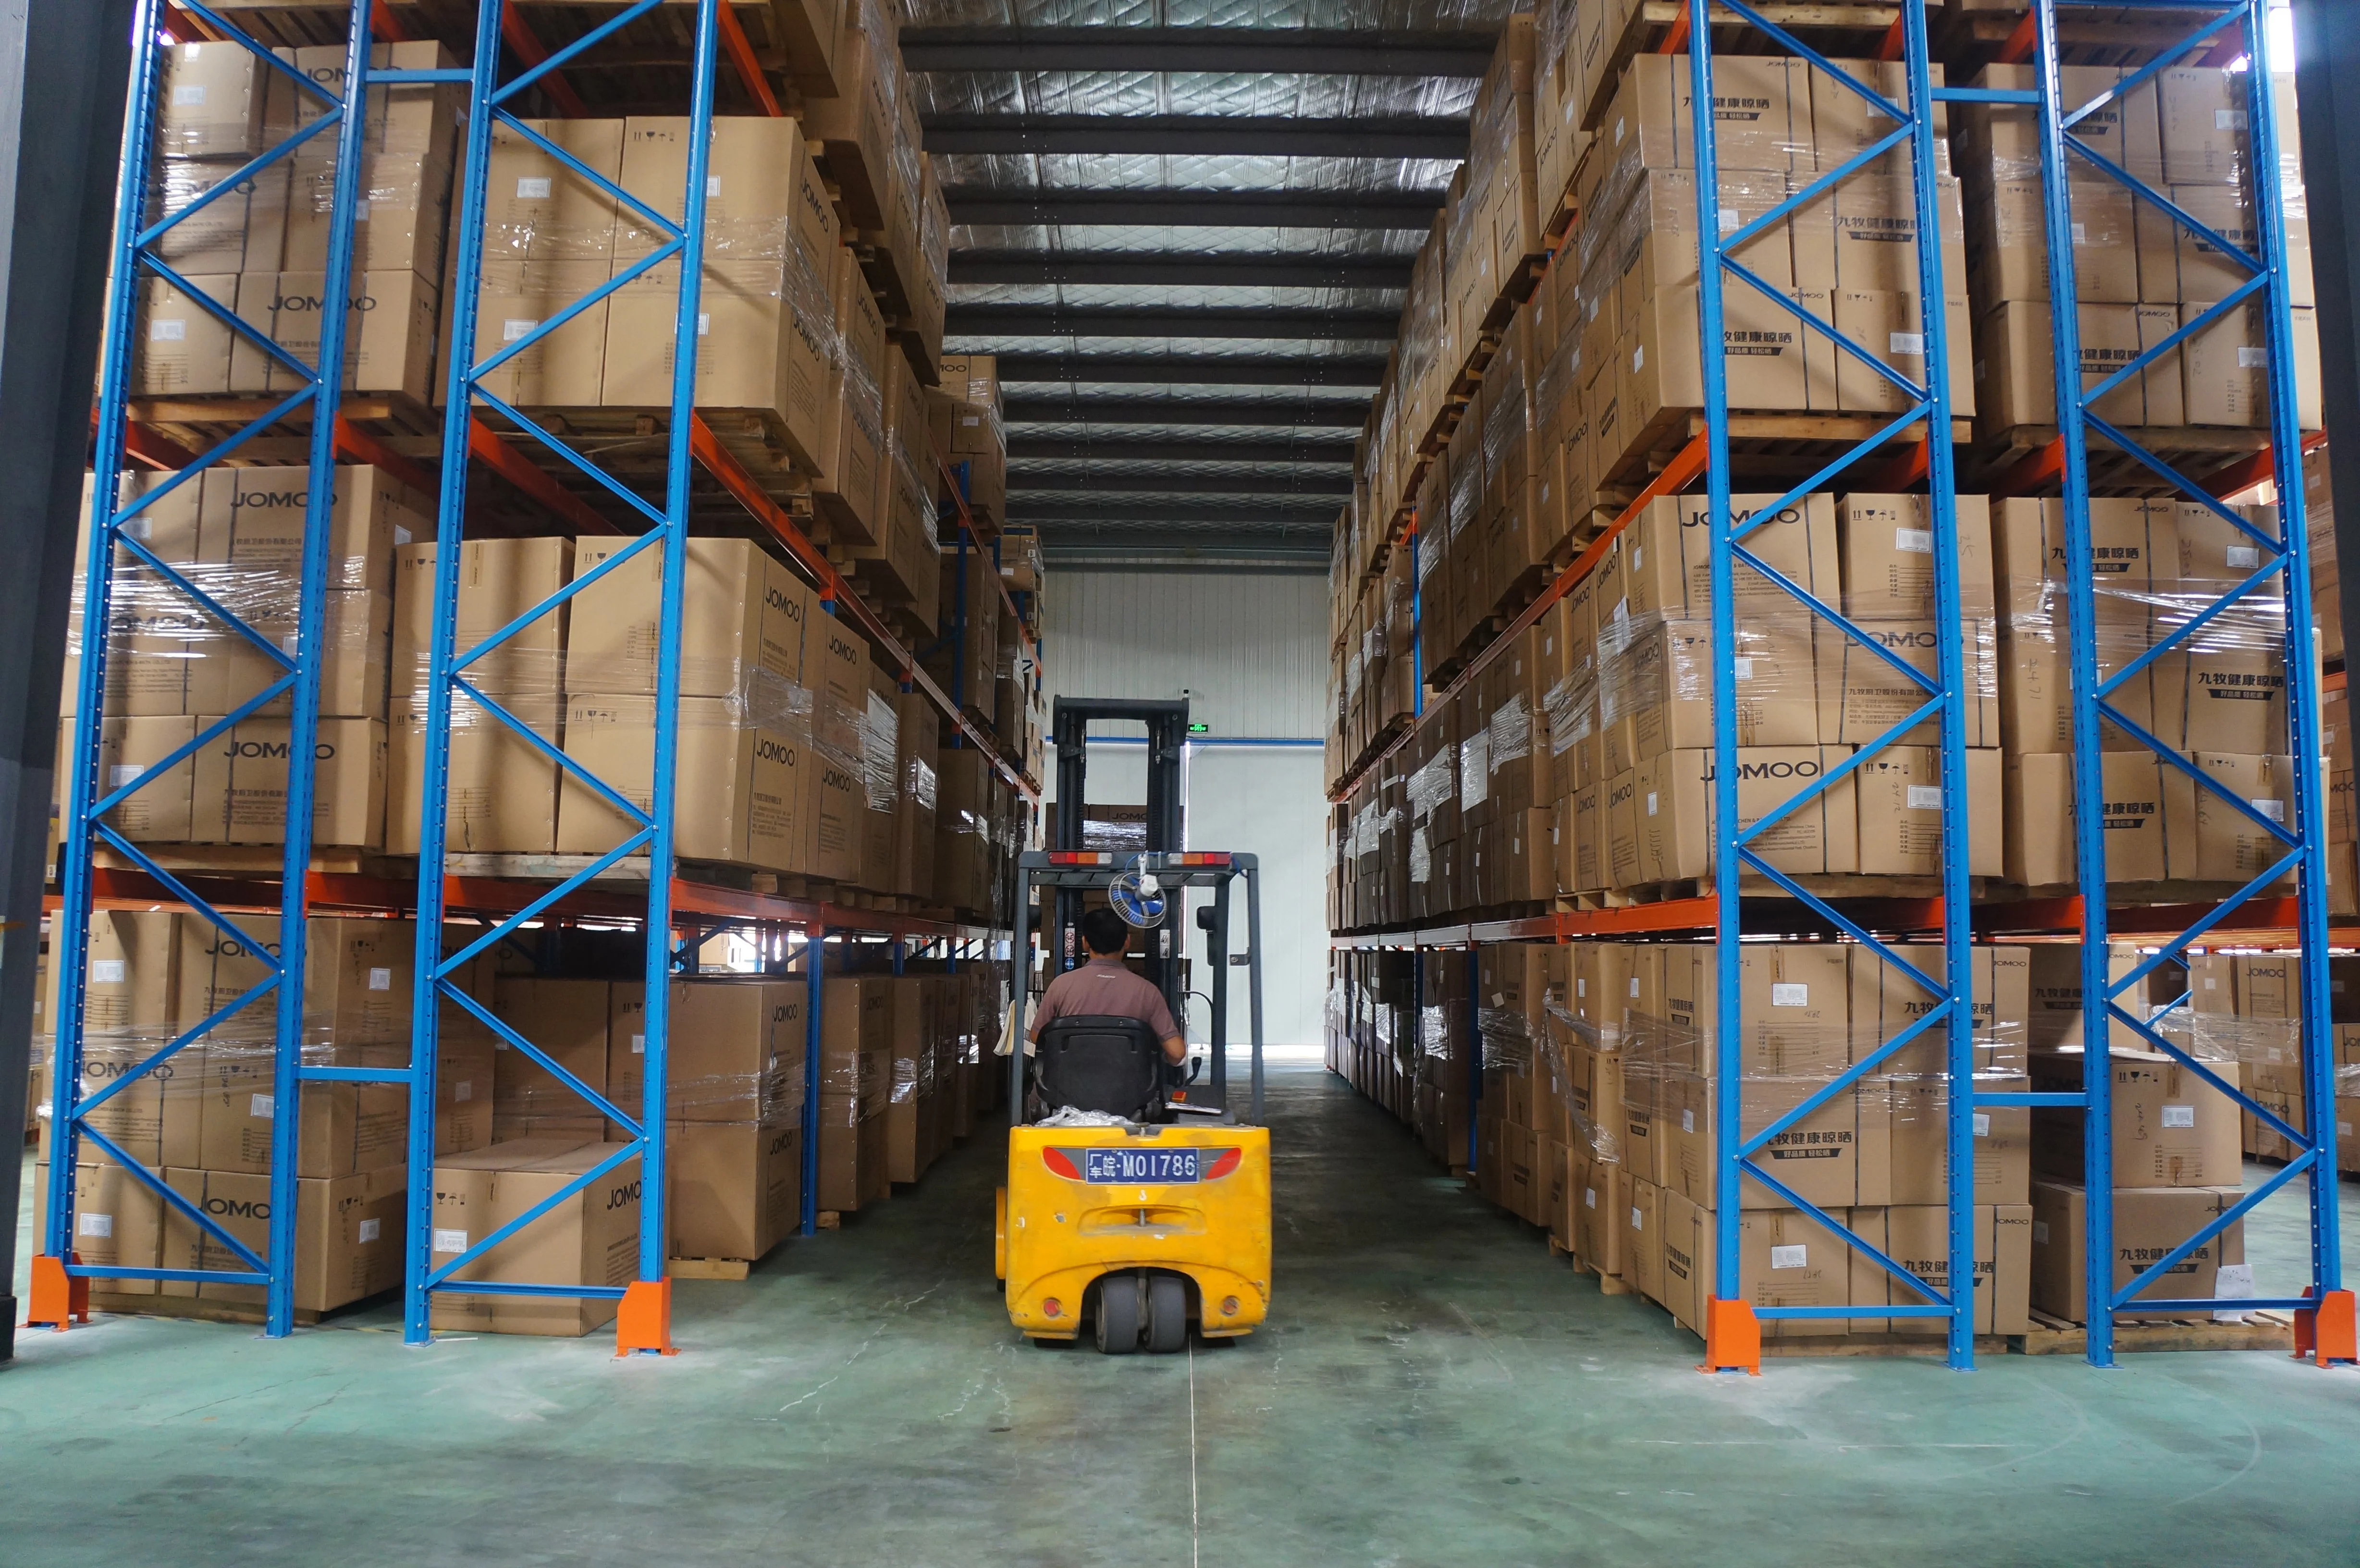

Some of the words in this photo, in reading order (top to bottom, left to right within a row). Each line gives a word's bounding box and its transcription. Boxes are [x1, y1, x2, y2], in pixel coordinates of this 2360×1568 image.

[1683, 96, 1770, 110] 九健康晾晒
[801, 177, 828, 233] JOMOO
[857, 294, 877, 336] JOMOO
[794, 318, 820, 362] JOMOO
[1724, 331, 1792, 343] 牧健康晾晒
[1568, 422, 1588, 454] JOMOO
[232, 491, 338, 508] JOMO
[1598, 554, 1616, 590] JOMOO
[765, 587, 800, 623] JOMOO
[1571, 585, 1590, 614] JOMOO
[829, 634, 857, 665] JOMOO
[1849, 688, 1926, 697] 九牧厨卫股份有限公
[2198, 672, 2284, 687] 九牧健康晾晒
[223, 742, 335, 760] JOMO
[757, 738, 795, 767] JOMOO
[823, 767, 850, 793] JOMOO
[1699, 761, 1819, 782] JMOO
[1577, 794, 1595, 816] JOMOO
[1609, 783, 1632, 809] JOMOO
[2247, 968, 2286, 979] JOMOO
[773, 1004, 798, 1023] JOMOO
[770, 1130, 793, 1156] JOMOO
[1766, 1131, 1852, 1146] 牧健康晾晒
[607, 1180, 642, 1210] JOMO
[197, 1197, 270, 1220] JOMO
